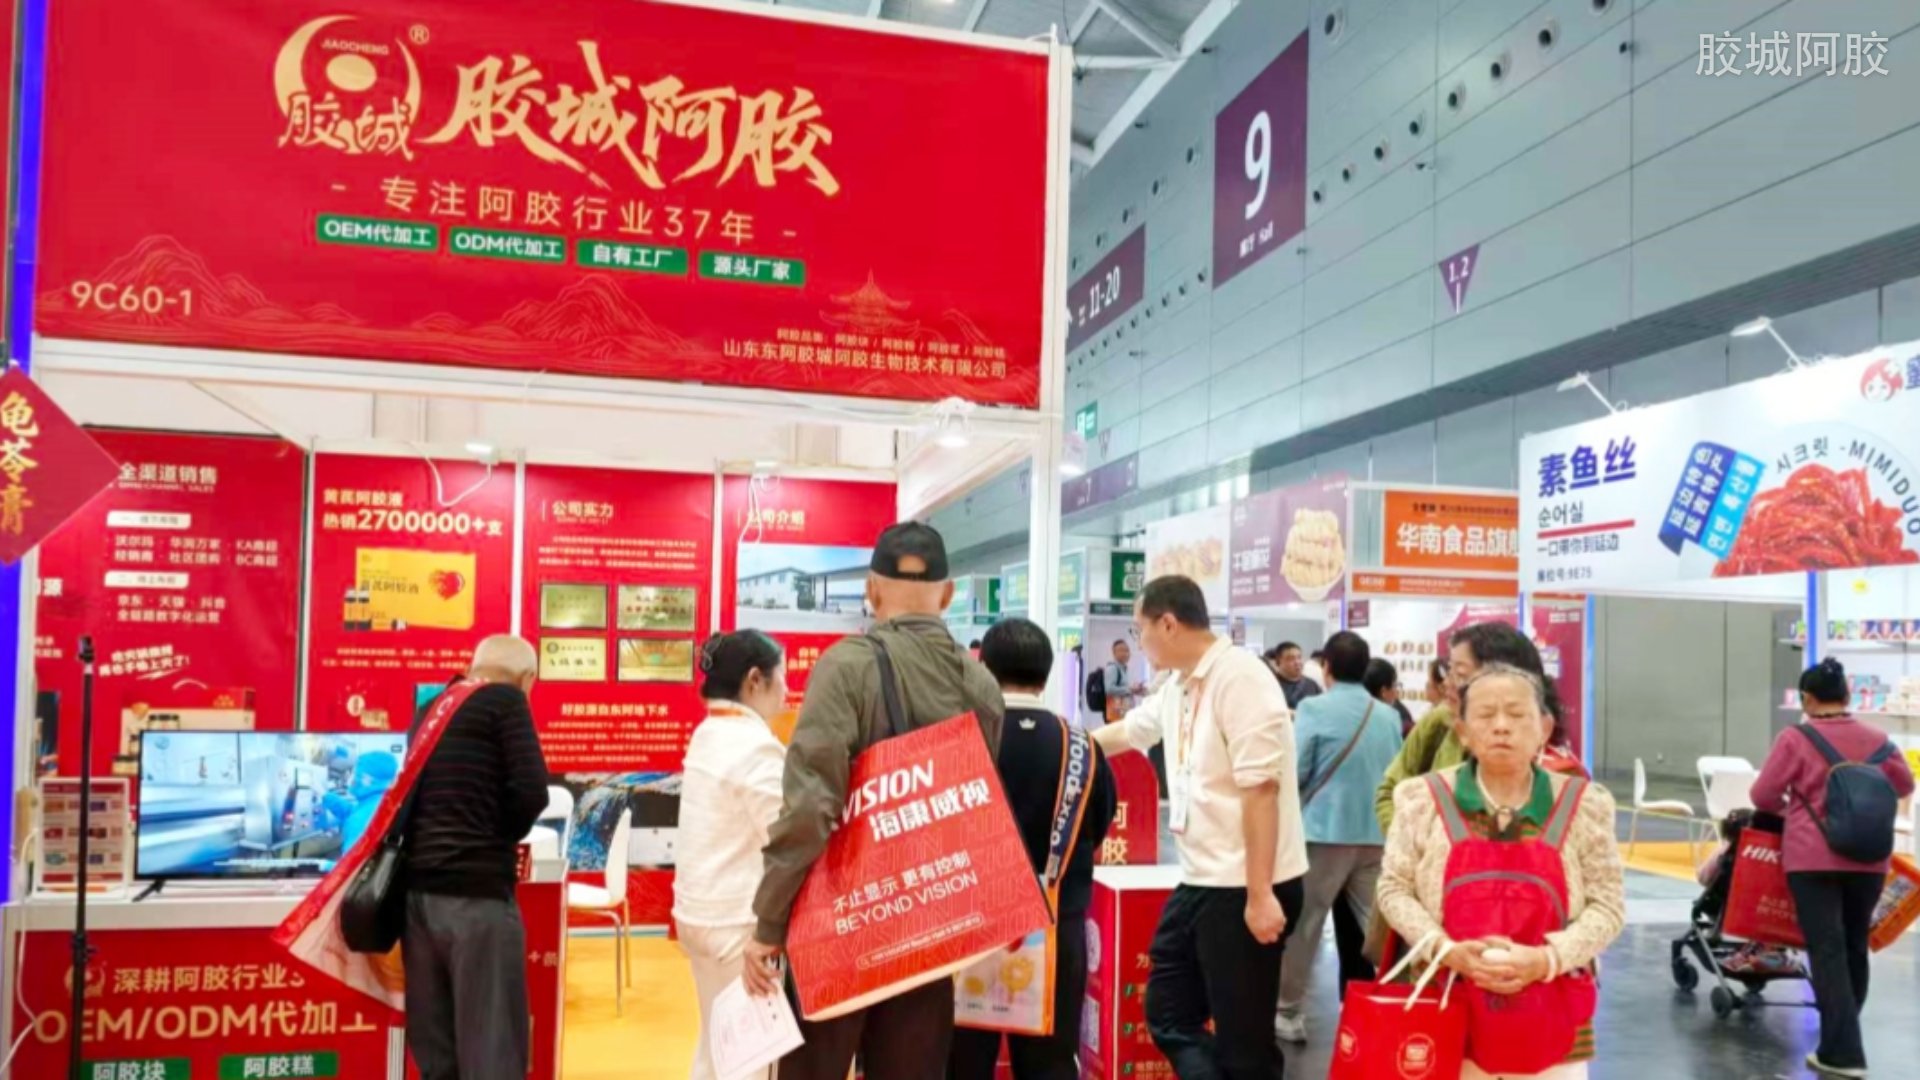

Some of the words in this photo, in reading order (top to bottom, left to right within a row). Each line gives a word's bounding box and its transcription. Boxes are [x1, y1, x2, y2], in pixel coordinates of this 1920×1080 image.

[277, 91, 414, 161] 胶城
[411, 39, 840, 197] 胶城阿胶
[1244, 110, 1272, 220] 9
[380, 175, 755, 247] 专注阿胶行业37年
[324, 220, 432, 247] OEM代加工
[455, 230, 563, 260] ODM代加工
[592, 243, 674, 270] 自有工厂
[713, 255, 791, 281] 源头厂家
[70, 279, 195, 316] 9C60-1
[1088, 265, 1121, 320] 11-20
[723, 338, 1007, 380] 山东东阿胶城阿胶生物技术有限公司
[118, 462, 218, 485] 全渠道销售
[1538, 434, 1637, 498] 素鱼丝
[322, 508, 503, 537] 热销2700000+支
[552, 500, 614, 518] 公司实力
[869, 776, 993, 843] 海康威视
[833, 876, 898, 913] 不止显示
[901, 850, 973, 889] 更有控制
[834, 894, 913, 936] BEYOND
[917, 870, 980, 905] VISION
[93, 1061, 166, 1080] 阿胶块
[244, 1054, 315, 1077] 阿胶糕
